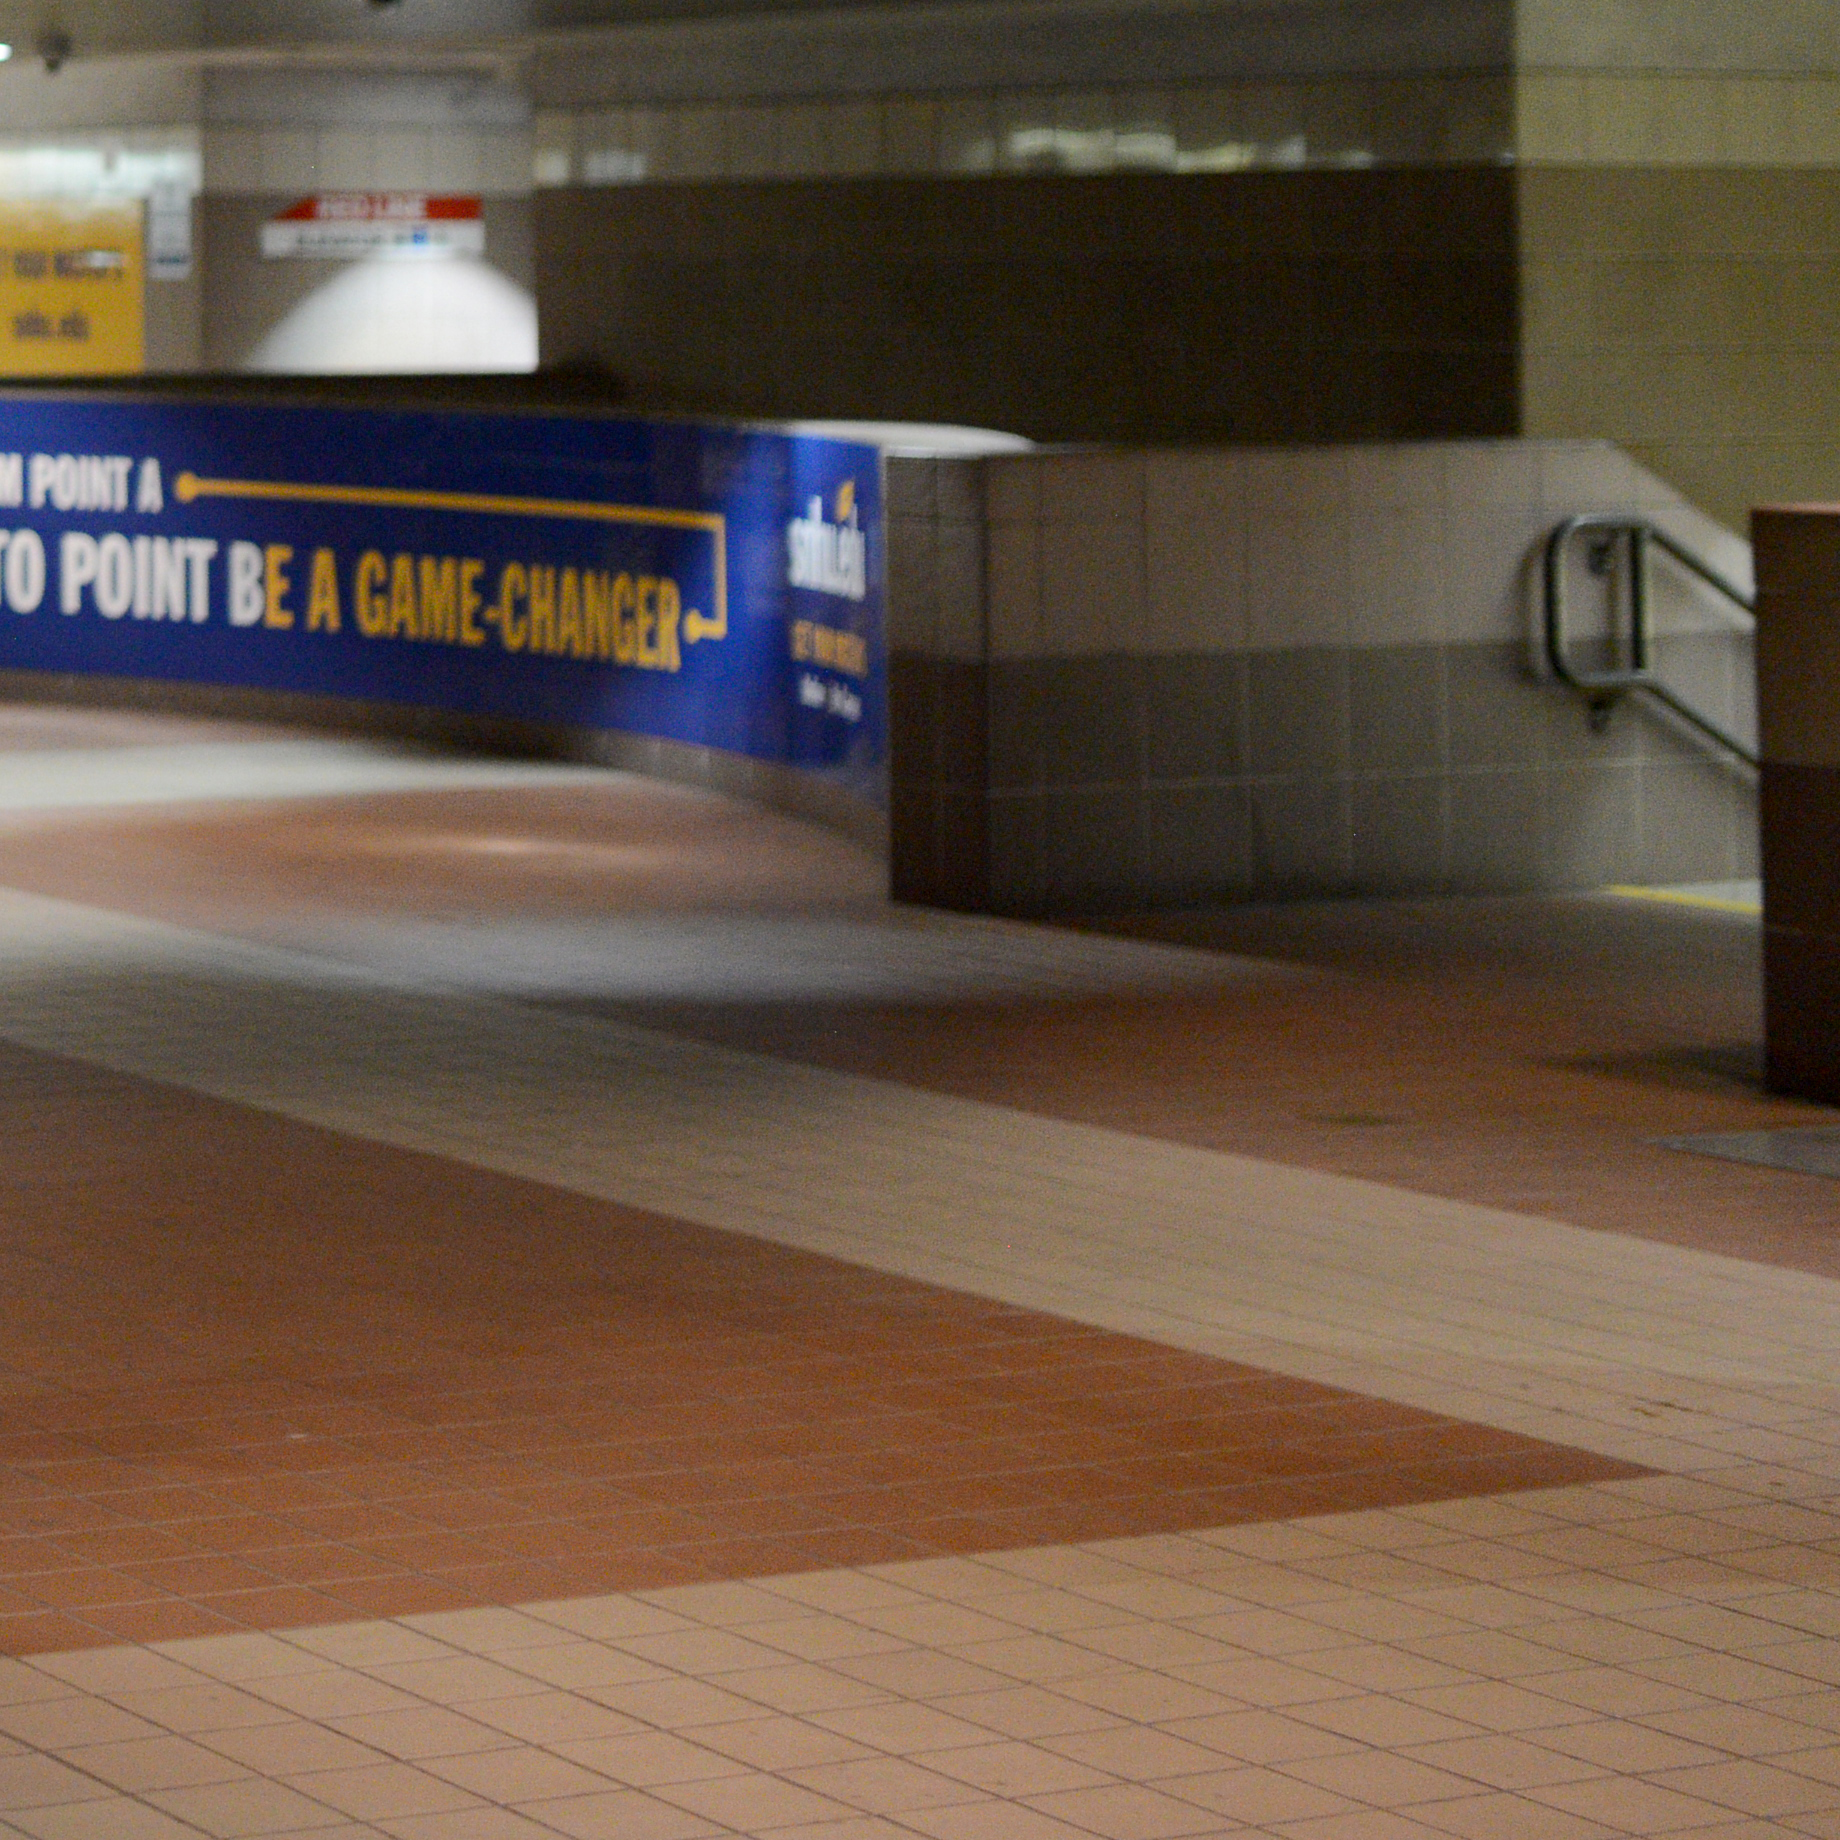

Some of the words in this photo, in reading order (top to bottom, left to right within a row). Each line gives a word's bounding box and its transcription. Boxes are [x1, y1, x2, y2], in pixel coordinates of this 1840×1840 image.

[29, 453, 132, 513] POINT
[136, 457, 164, 514] A
[60, 531, 218, 624] POINT
[228, 541, 295, 628] BE
[306, 547, 342, 633] A
[354, 551, 682, 673] GAME-CHANGER
